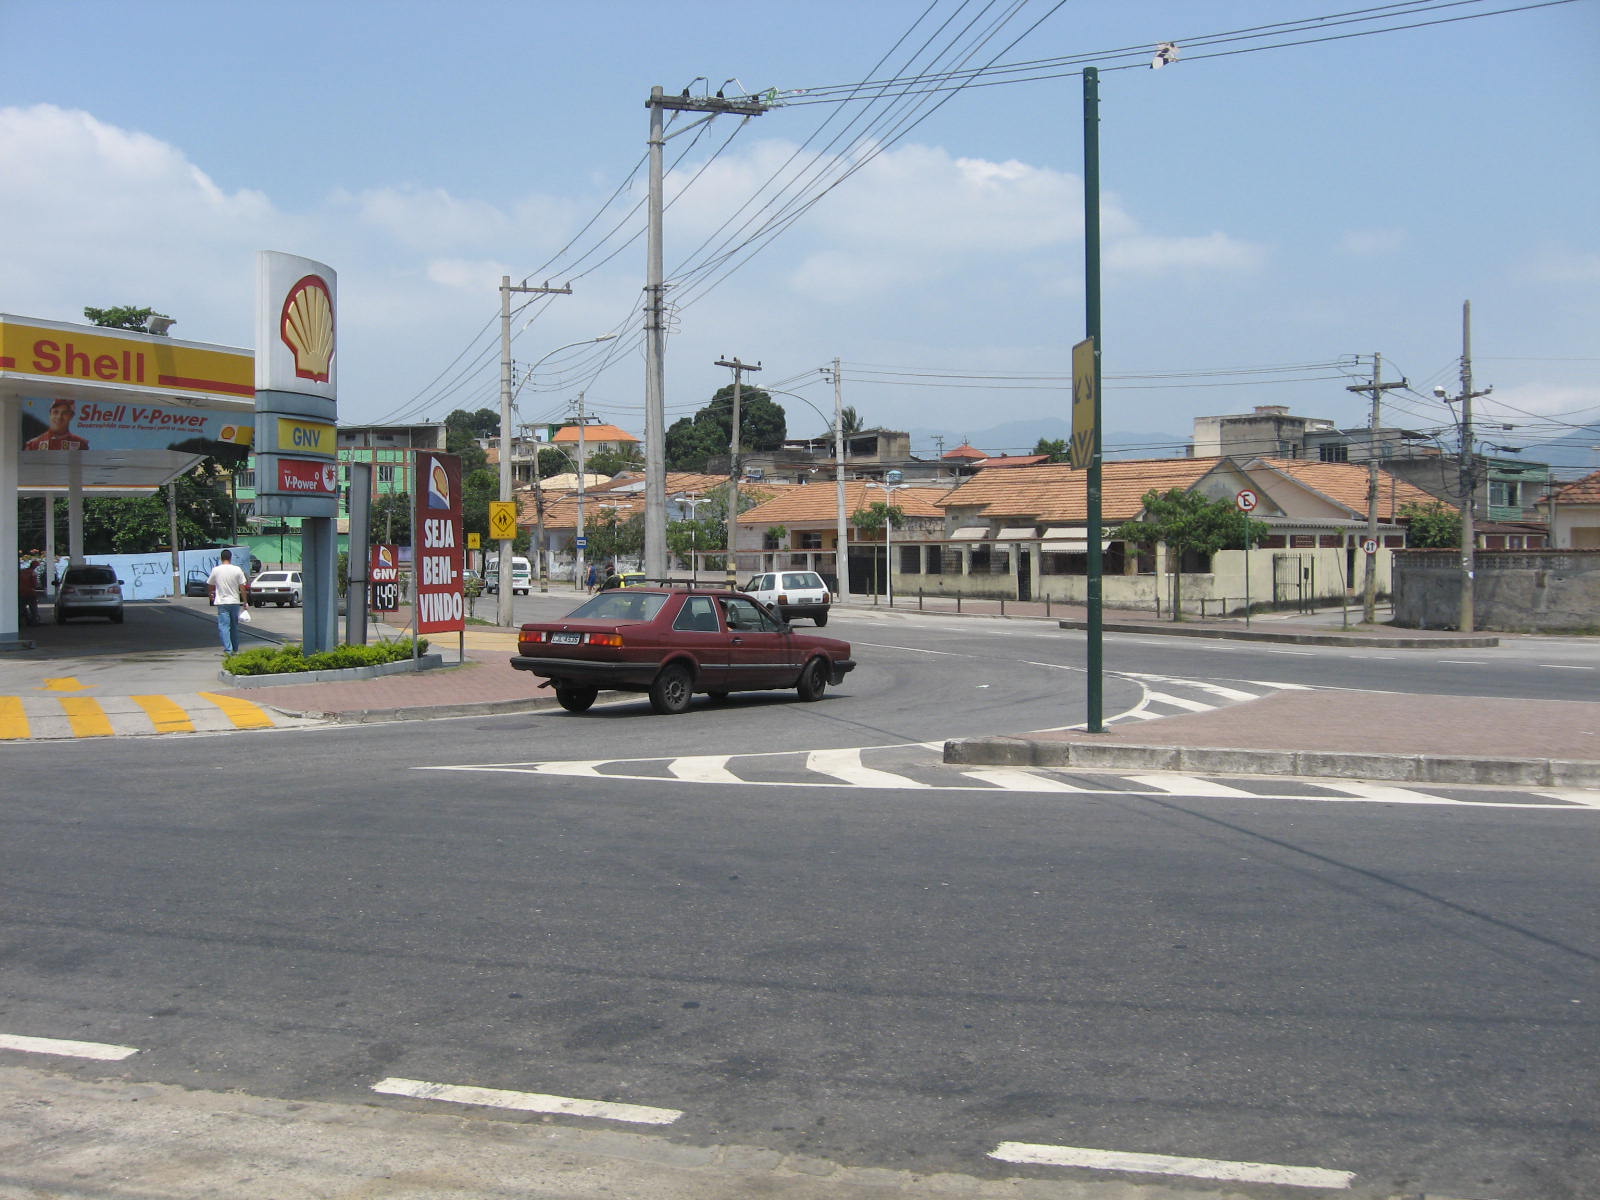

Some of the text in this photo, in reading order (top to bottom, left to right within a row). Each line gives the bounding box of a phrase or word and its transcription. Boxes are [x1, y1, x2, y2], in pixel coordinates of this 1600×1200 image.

[33, 340, 144, 382] Shell
[79, 404, 208, 427] Shell V-Power
[293, 427, 320, 448] GNV
[284, 475, 317, 490] V-Power
[424, 519, 455, 548] SEJA
[373, 568, 397, 580] GNV
[423, 556, 458, 585] BEM-
[420, 592, 463, 622] VINDO
